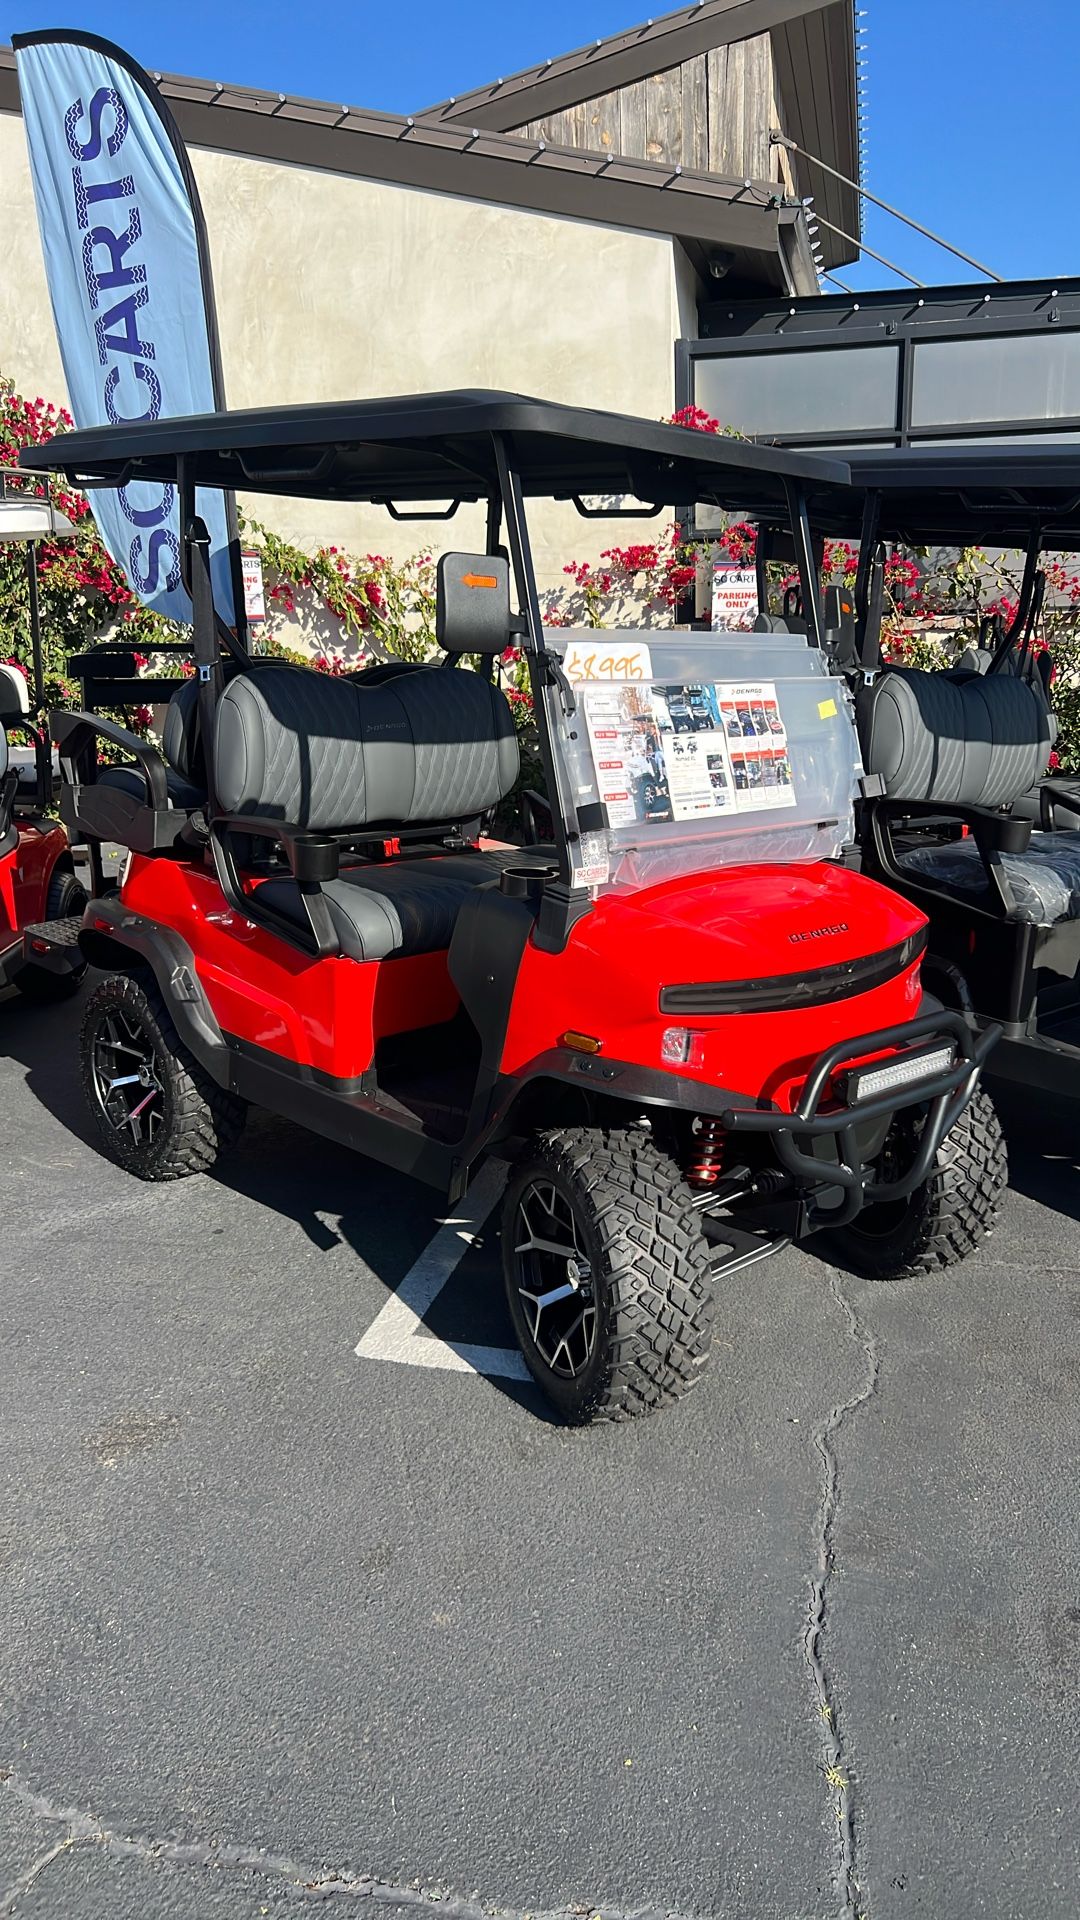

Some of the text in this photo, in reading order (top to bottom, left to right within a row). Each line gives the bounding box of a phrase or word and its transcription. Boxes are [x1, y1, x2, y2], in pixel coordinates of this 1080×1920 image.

[714, 574, 755, 583] SO CART
[717, 592, 757, 600] PARKING
[789, 923, 849, 944] DENAGO
